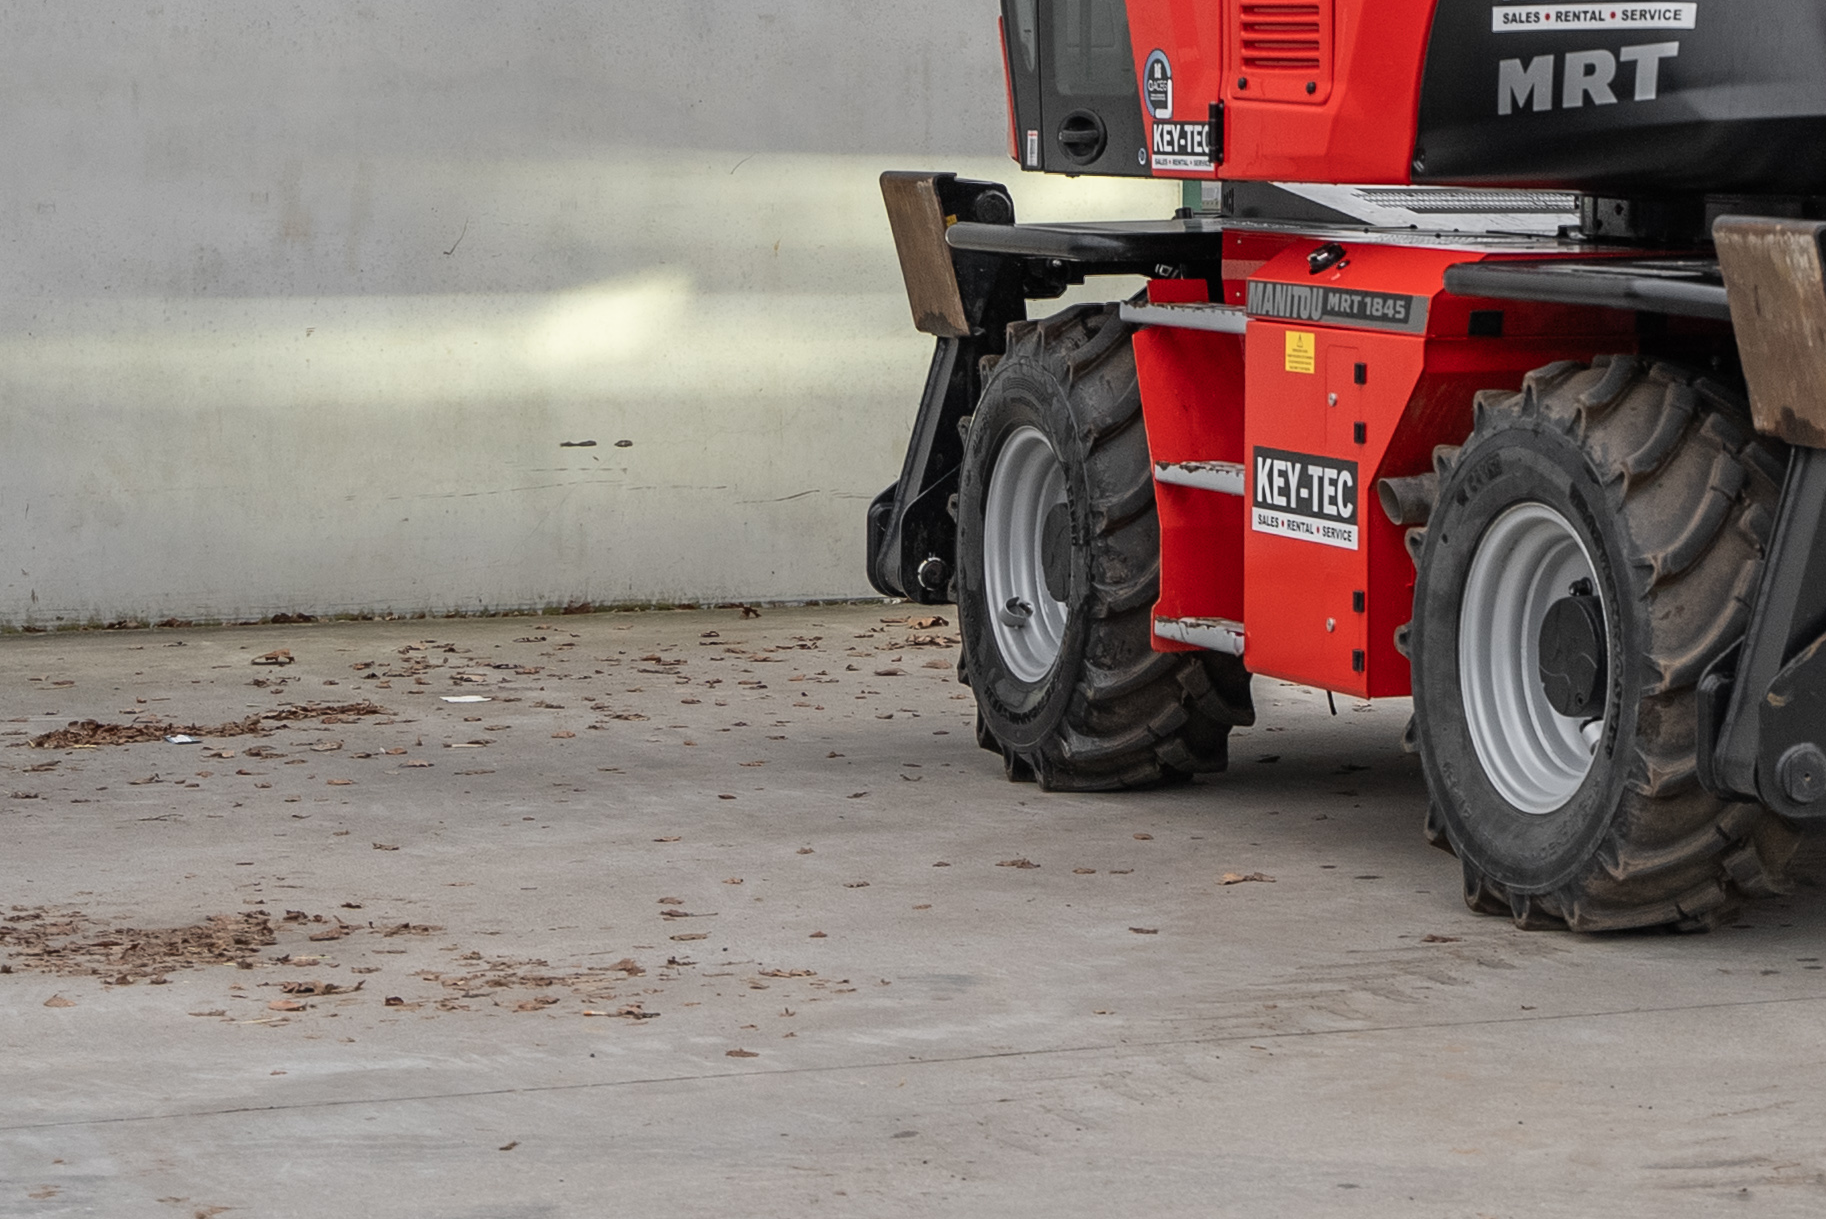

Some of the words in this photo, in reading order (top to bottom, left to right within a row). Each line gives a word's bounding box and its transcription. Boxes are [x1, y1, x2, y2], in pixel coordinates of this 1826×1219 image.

[1503, 11, 1541, 24] SALES
[1555, 10, 1605, 22] RENTAL
[1621, 8, 1683, 21] SERVICE
[1498, 41, 1680, 115] MRT
[1248, 281, 1324, 321] MANITOU
[1327, 292, 1362, 314] MRT
[1364, 296, 1406, 319] 1845
[1257, 456, 1354, 519] KEY-TEC
[1257, 513, 1280, 528] SALES
[1287, 519, 1314, 535] RENTAL
[1322, 525, 1352, 542] SERVICE
